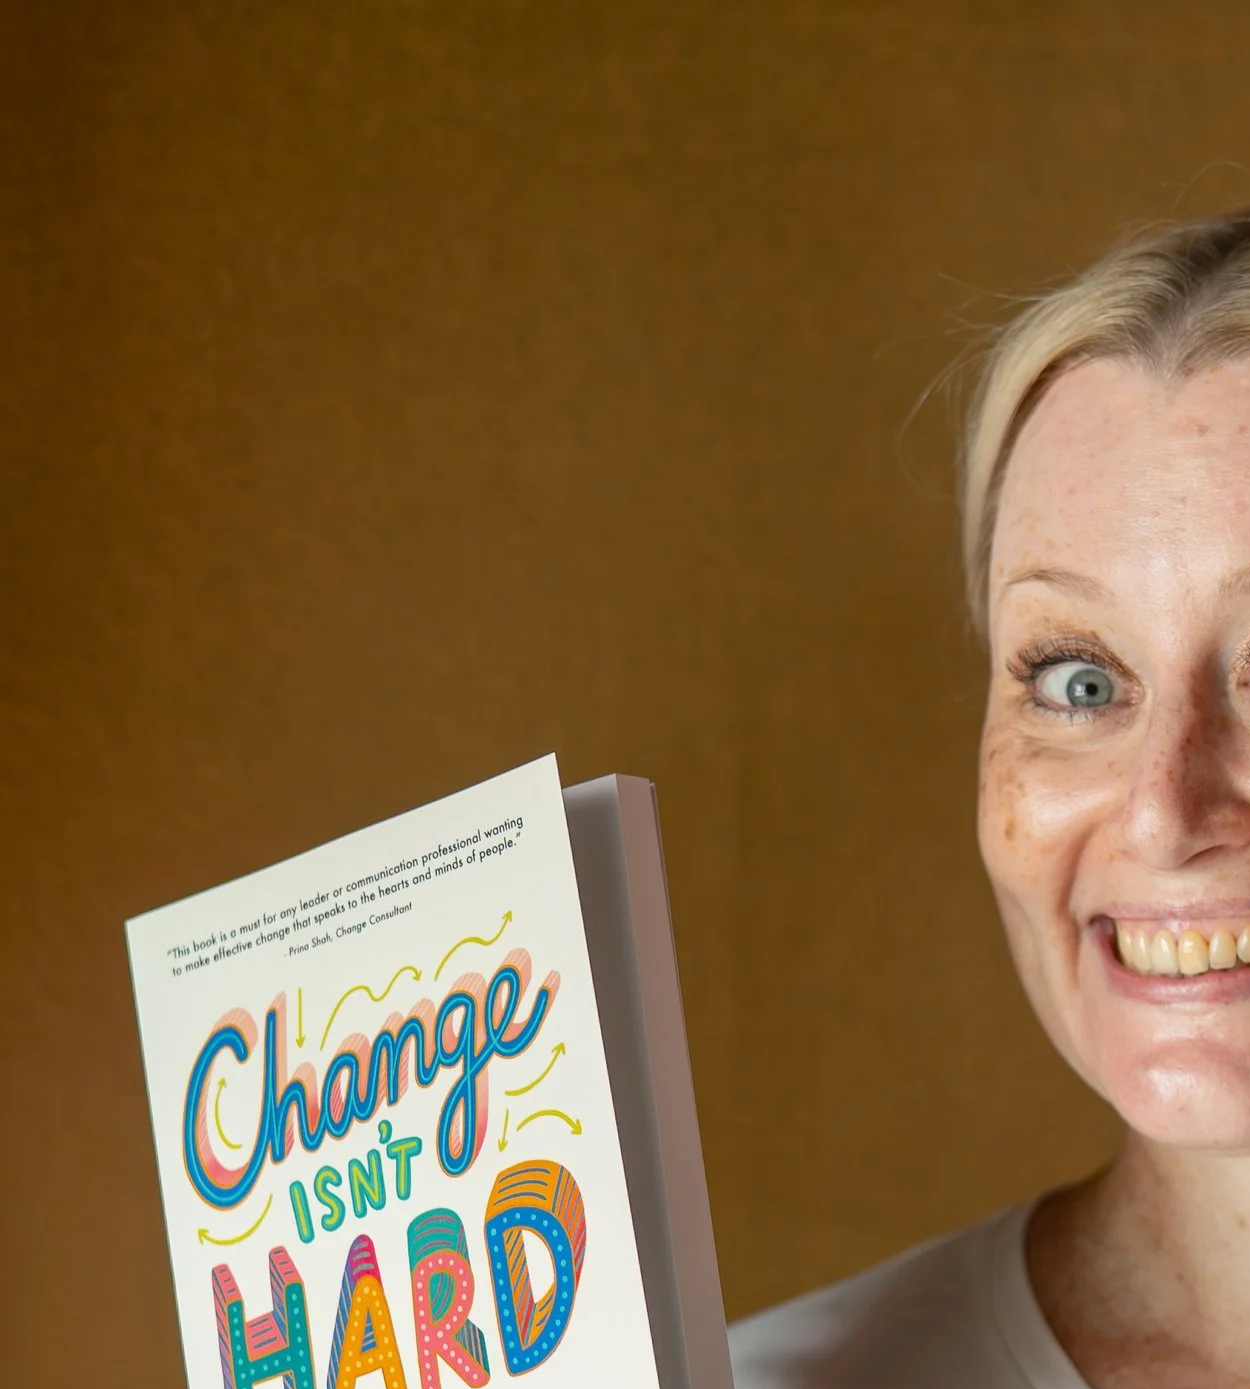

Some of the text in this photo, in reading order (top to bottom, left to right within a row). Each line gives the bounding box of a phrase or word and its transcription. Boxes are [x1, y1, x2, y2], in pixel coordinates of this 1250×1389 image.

[167, 945, 191, 959] "This
[192, 933, 217, 953] book
[239, 918, 261, 935] must
[262, 913, 277, 926] for
[279, 906, 297, 920] any
[299, 892, 330, 911] leader
[332, 887, 343, 898] or
[345, 858, 419, 893] communication
[421, 829, 482, 867] professional
[483, 816, 524, 839] wanting
[172, 831, 521, 977] to make effective change that speaks to the hearts and minds of people."
[288, 943, 310, 957] Prina
[311, 932, 333, 949] Shah,
[335, 921, 367, 938] Change
[369, 901, 412, 925] Consultant
[183, 947, 561, 1211] Change
[289, 1120, 422, 1243] ISN'T
